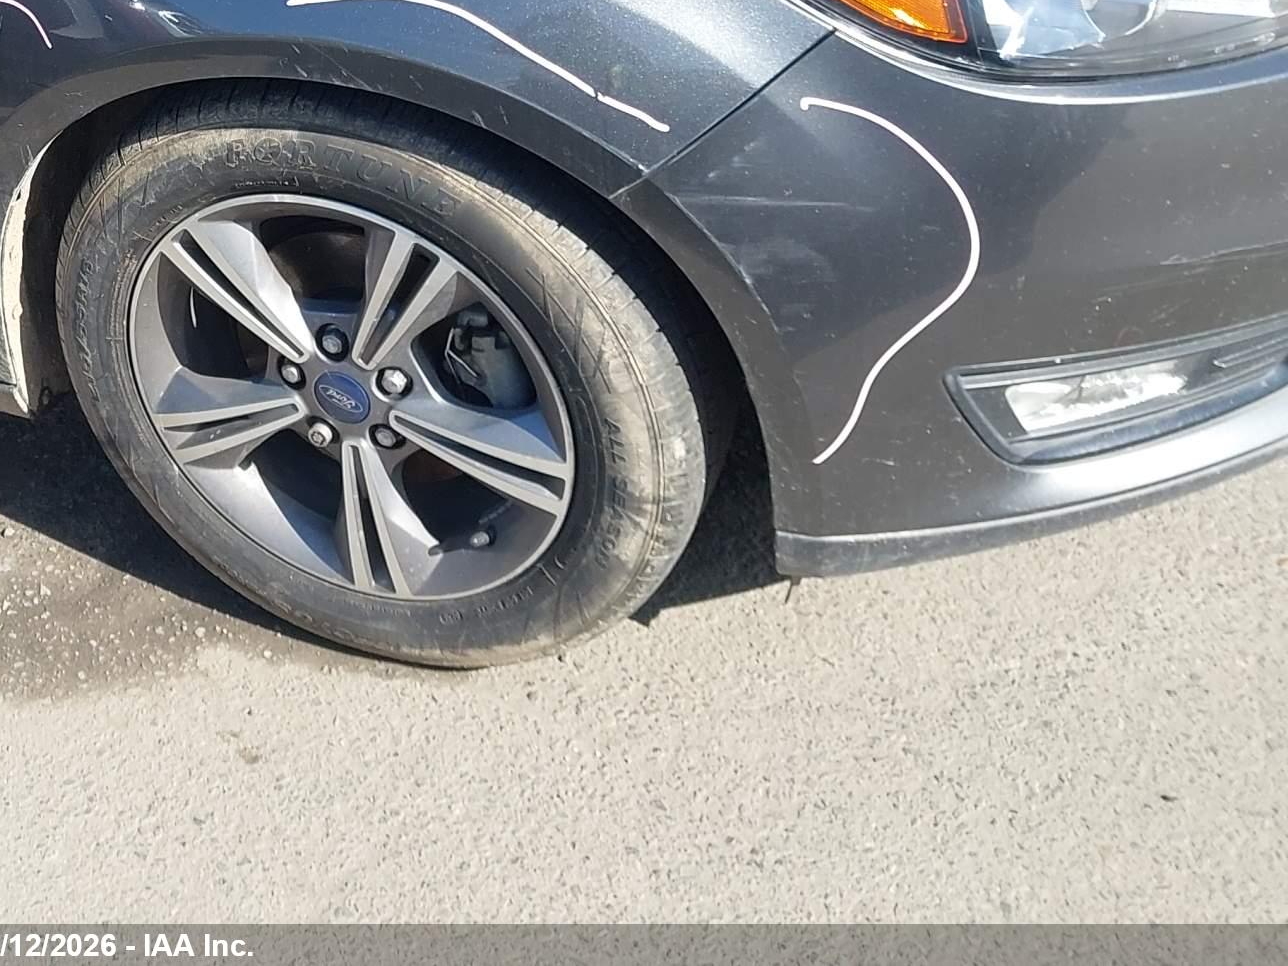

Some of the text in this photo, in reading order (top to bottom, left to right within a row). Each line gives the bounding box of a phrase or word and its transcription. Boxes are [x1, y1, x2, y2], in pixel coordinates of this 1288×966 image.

[223, 136, 465, 217] FORTUNE
[326, 389, 356, 409] Ford
[594, 418, 628, 569] ALL SEASON
